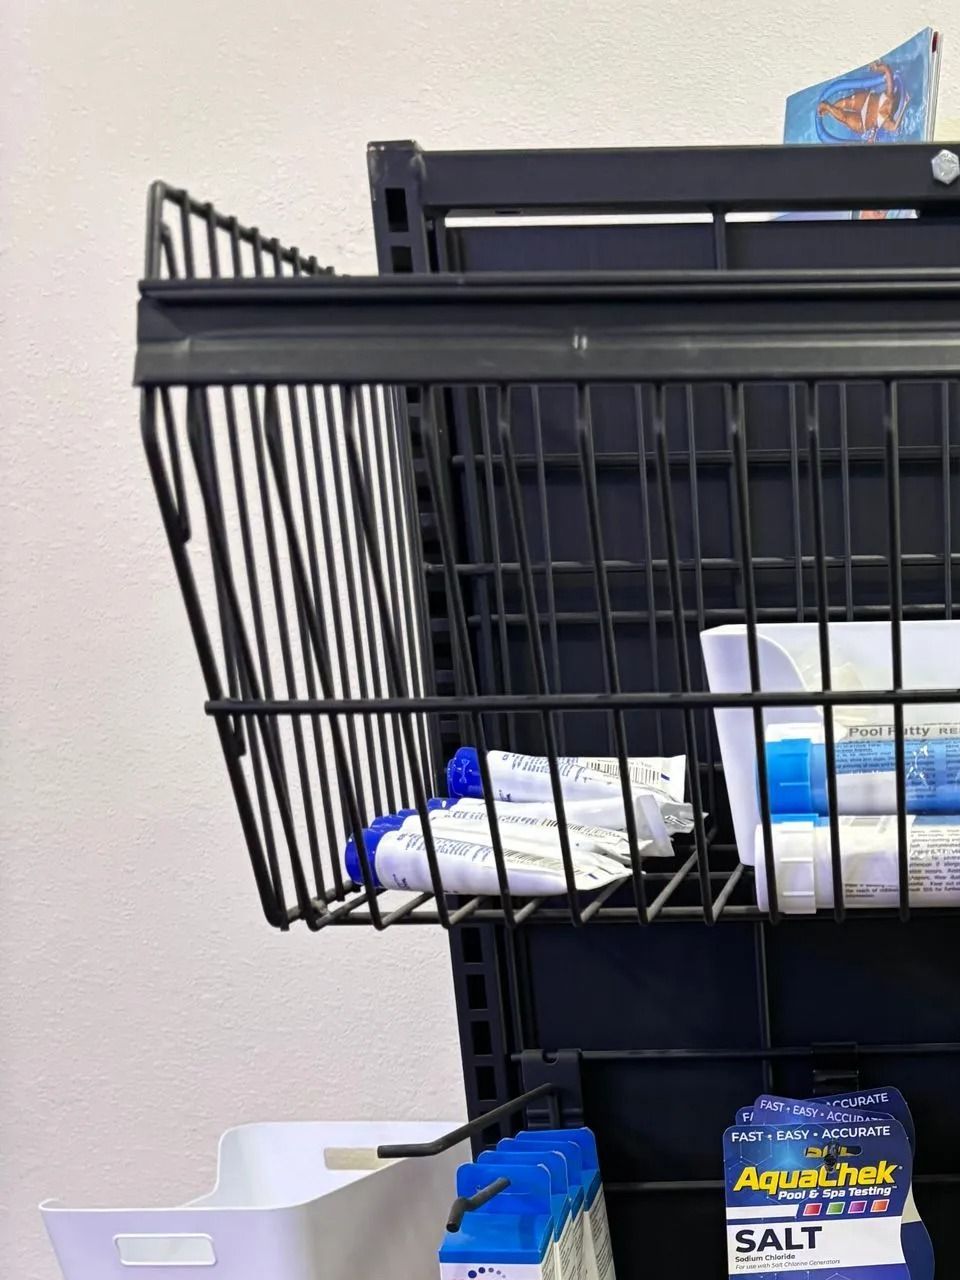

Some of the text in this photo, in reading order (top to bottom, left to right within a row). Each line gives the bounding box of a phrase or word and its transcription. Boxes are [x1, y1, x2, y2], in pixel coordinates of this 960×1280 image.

[849, 727, 883, 737] Pool
[760, 1100, 785, 1112] FAST
[793, 1106, 818, 1118] EASY
[731, 1126, 890, 1142] FAST EASY ACCURATE
[778, 1190, 805, 1200] Pool
[808, 1189, 819, 1198] &
[822, 1188, 846, 1199] Spa
[734, 1226, 823, 1253] SALT
[735, 1255, 763, 1263] Sodium
